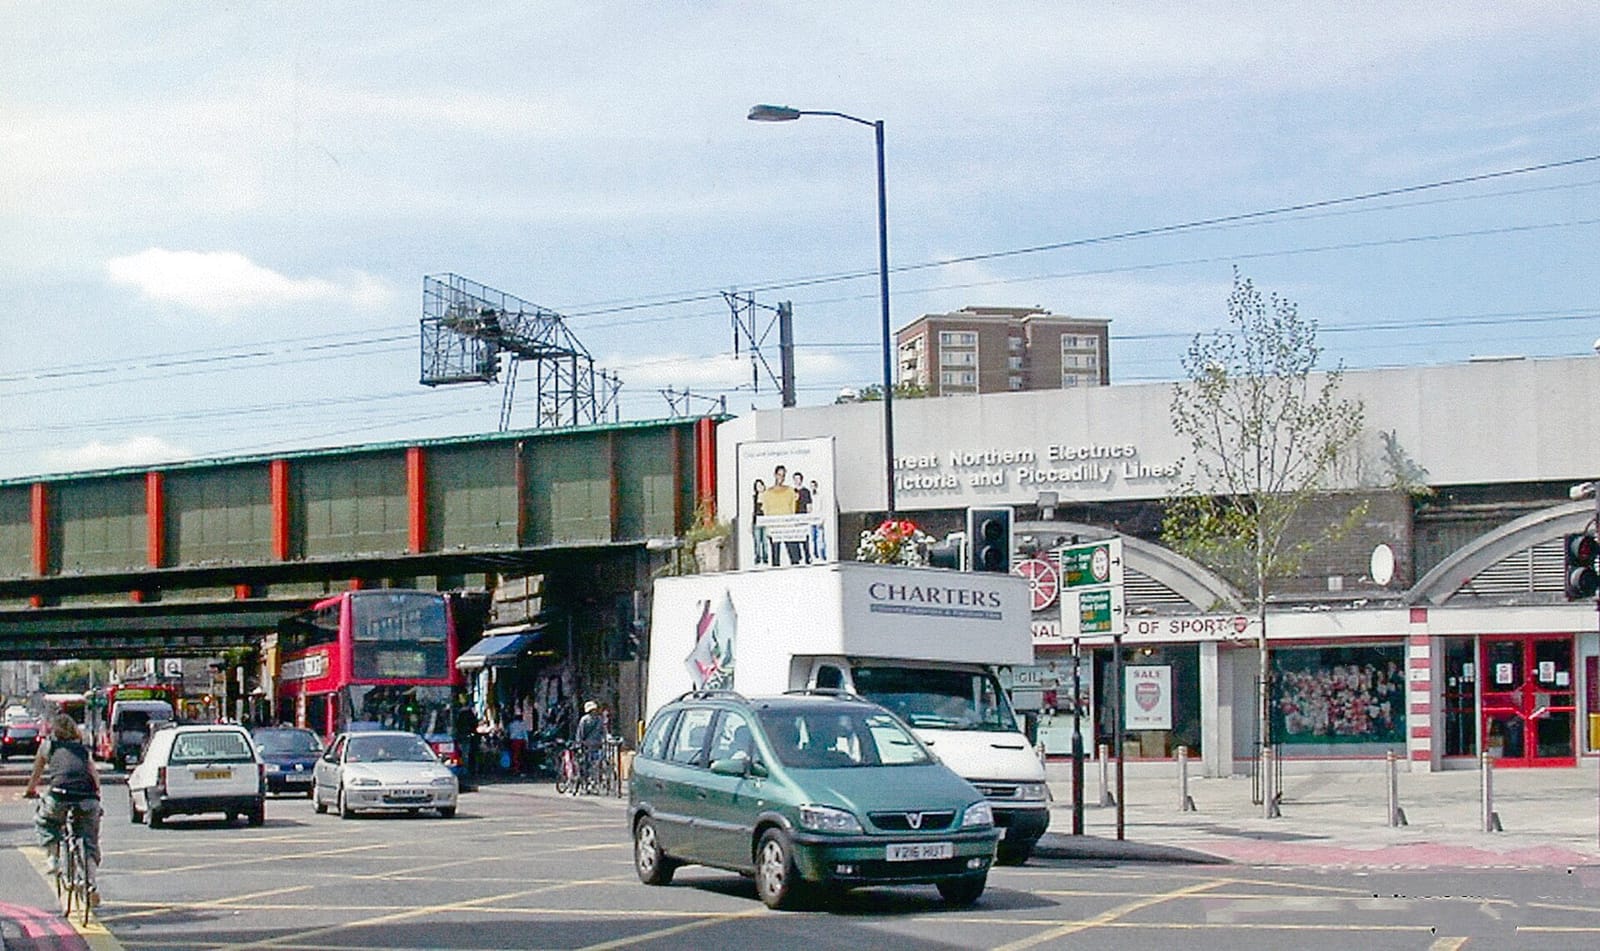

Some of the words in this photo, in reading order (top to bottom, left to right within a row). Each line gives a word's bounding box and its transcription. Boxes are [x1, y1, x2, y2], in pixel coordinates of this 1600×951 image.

[949, 447, 1037, 467] Northern
[1047, 443, 1137, 461] Electrics
[968, 469, 1004, 487] and
[1016, 463, 1112, 484] Piccadilly
[1122, 460, 1180, 480] Lines
[868, 581, 1001, 608] CHARTERS
[1138, 619, 1160, 635] OF
